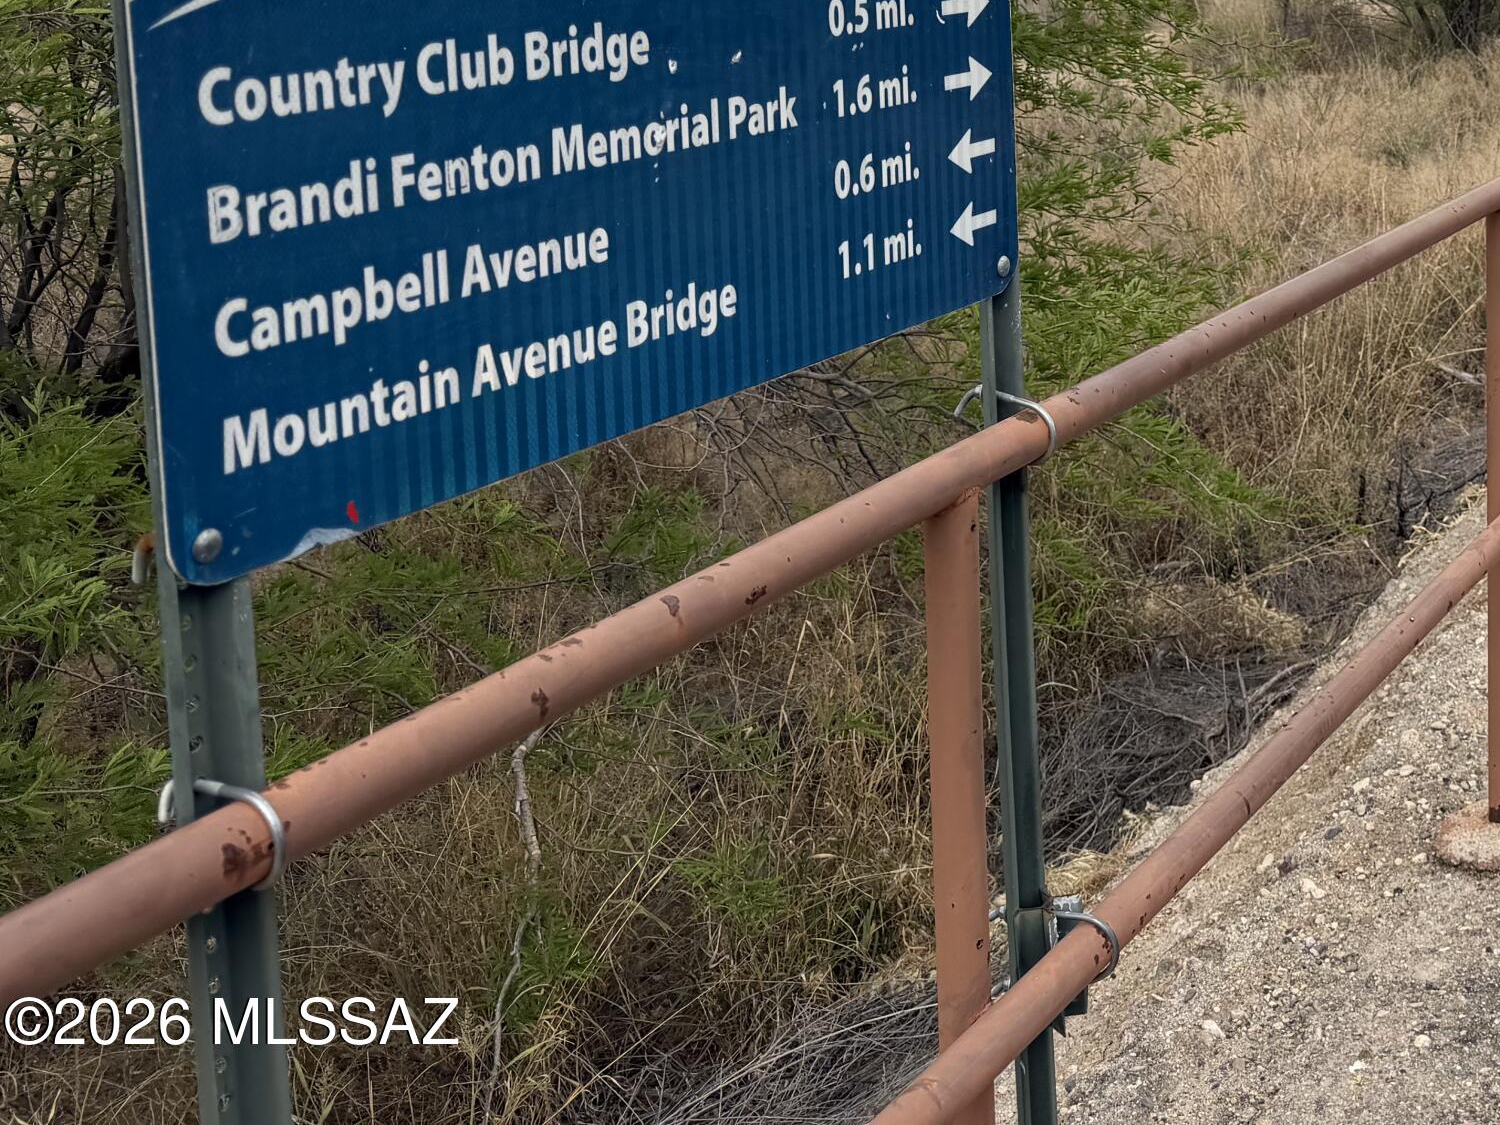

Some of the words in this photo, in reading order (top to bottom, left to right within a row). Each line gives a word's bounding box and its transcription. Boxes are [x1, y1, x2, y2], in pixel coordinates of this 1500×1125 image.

[198, 56, 406, 126] Country
[416, 34, 515, 95] Club
[524, 22, 650, 83] Bridge
[207, 157, 380, 245] Brandi
[391, 144, 541, 208] Fenton
[551, 98, 720, 176] Memorial
[728, 86, 799, 140] Park
[832, 74, 873, 118] 1.6
[878, 64, 917, 109] mi.
[214, 249, 450, 358] Campbell
[461, 227, 609, 298] Avenue
[834, 153, 876, 200] 0.6
[881, 141, 920, 188] mi.
[223, 359, 461, 475] Mountain
[471, 320, 618, 398] Avenue
[626, 281, 737, 348] Bridge
[838, 233, 875, 279] 1.1
[883, 218, 922, 266] mi.
